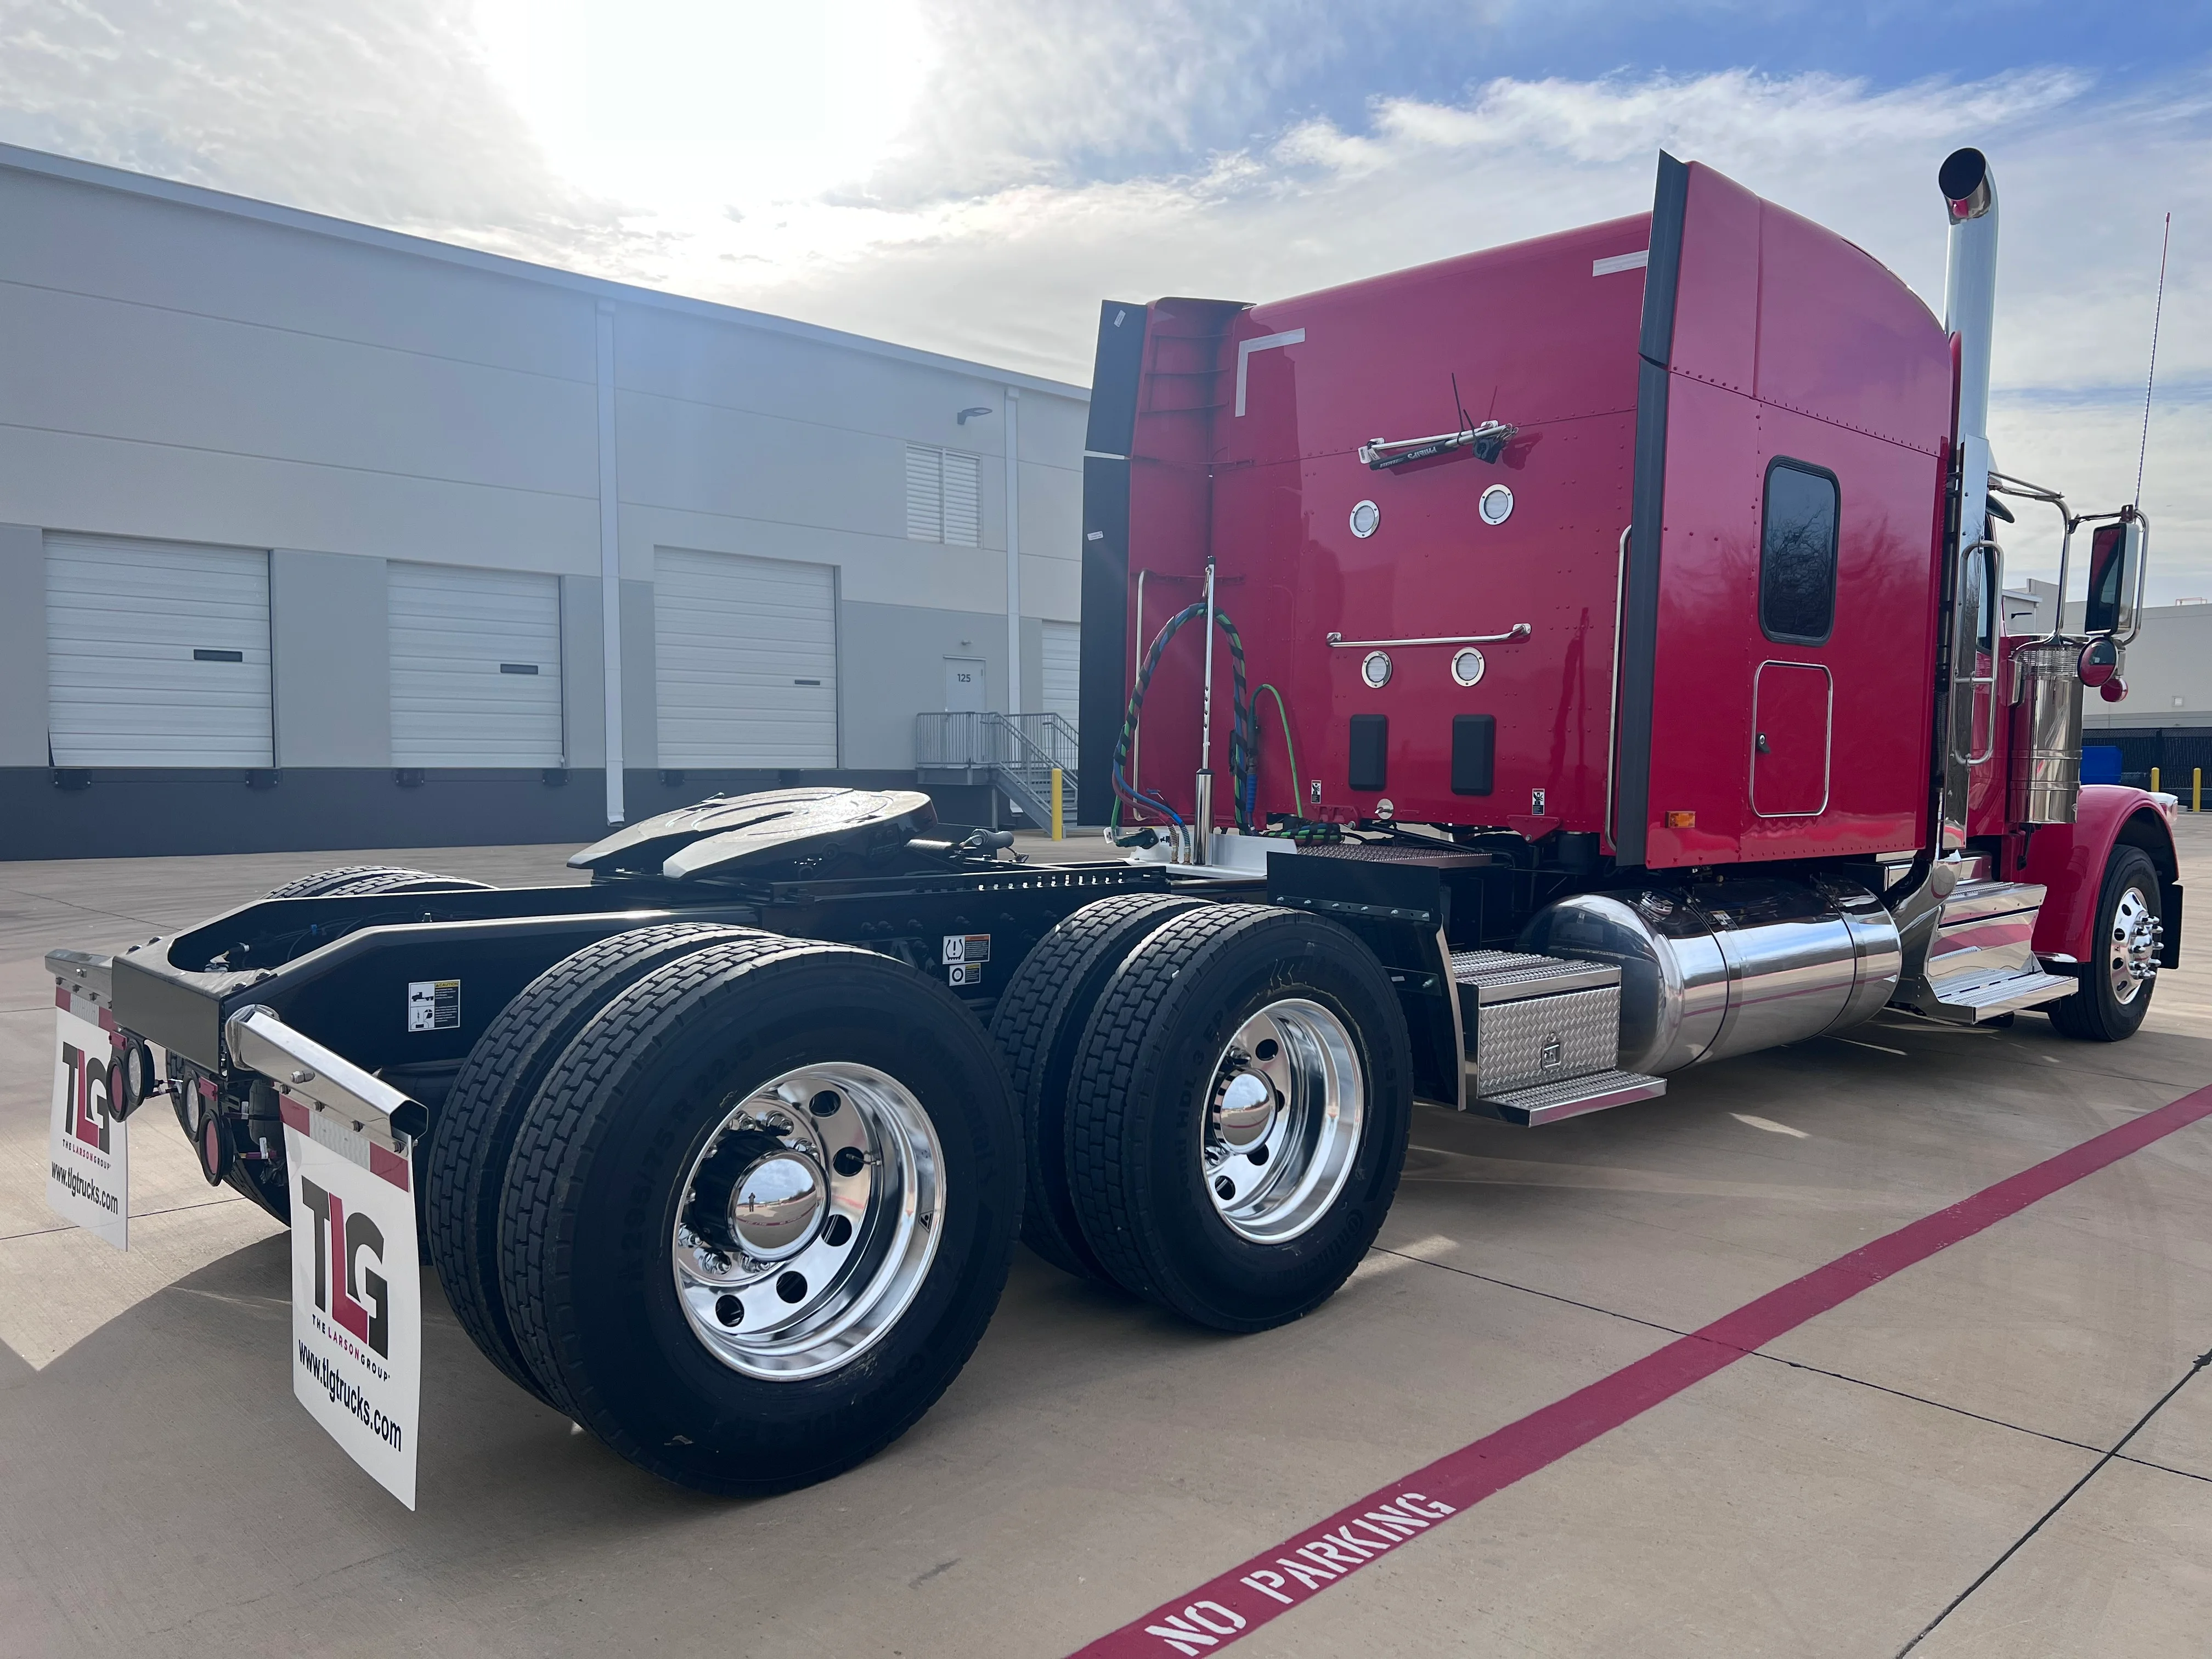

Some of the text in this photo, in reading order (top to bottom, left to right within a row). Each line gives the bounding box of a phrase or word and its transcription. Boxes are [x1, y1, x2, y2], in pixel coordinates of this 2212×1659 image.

[1407, 446, 1438, 460] PHILIPS
[957, 674, 971, 682] 125
[62, 1041, 110, 1155] TLG
[693, 1036, 755, 1098] 22.5
[1176, 1076, 1198, 1128] HDL
[1192, 1049, 1205, 1066] 3
[1203, 1009, 1223, 1044] EP
[51, 1161, 119, 1215] www.tlgtrucks.com
[63, 1139, 110, 1170] THE LARSON GROUP
[301, 1175, 388, 1360] TLG
[312, 1314, 388, 1382] THE LARSON GROUP
[298, 1339, 402, 1452] www.tlgtrucks.com
[1144, 1492, 1457, 1657] NO PARKING
